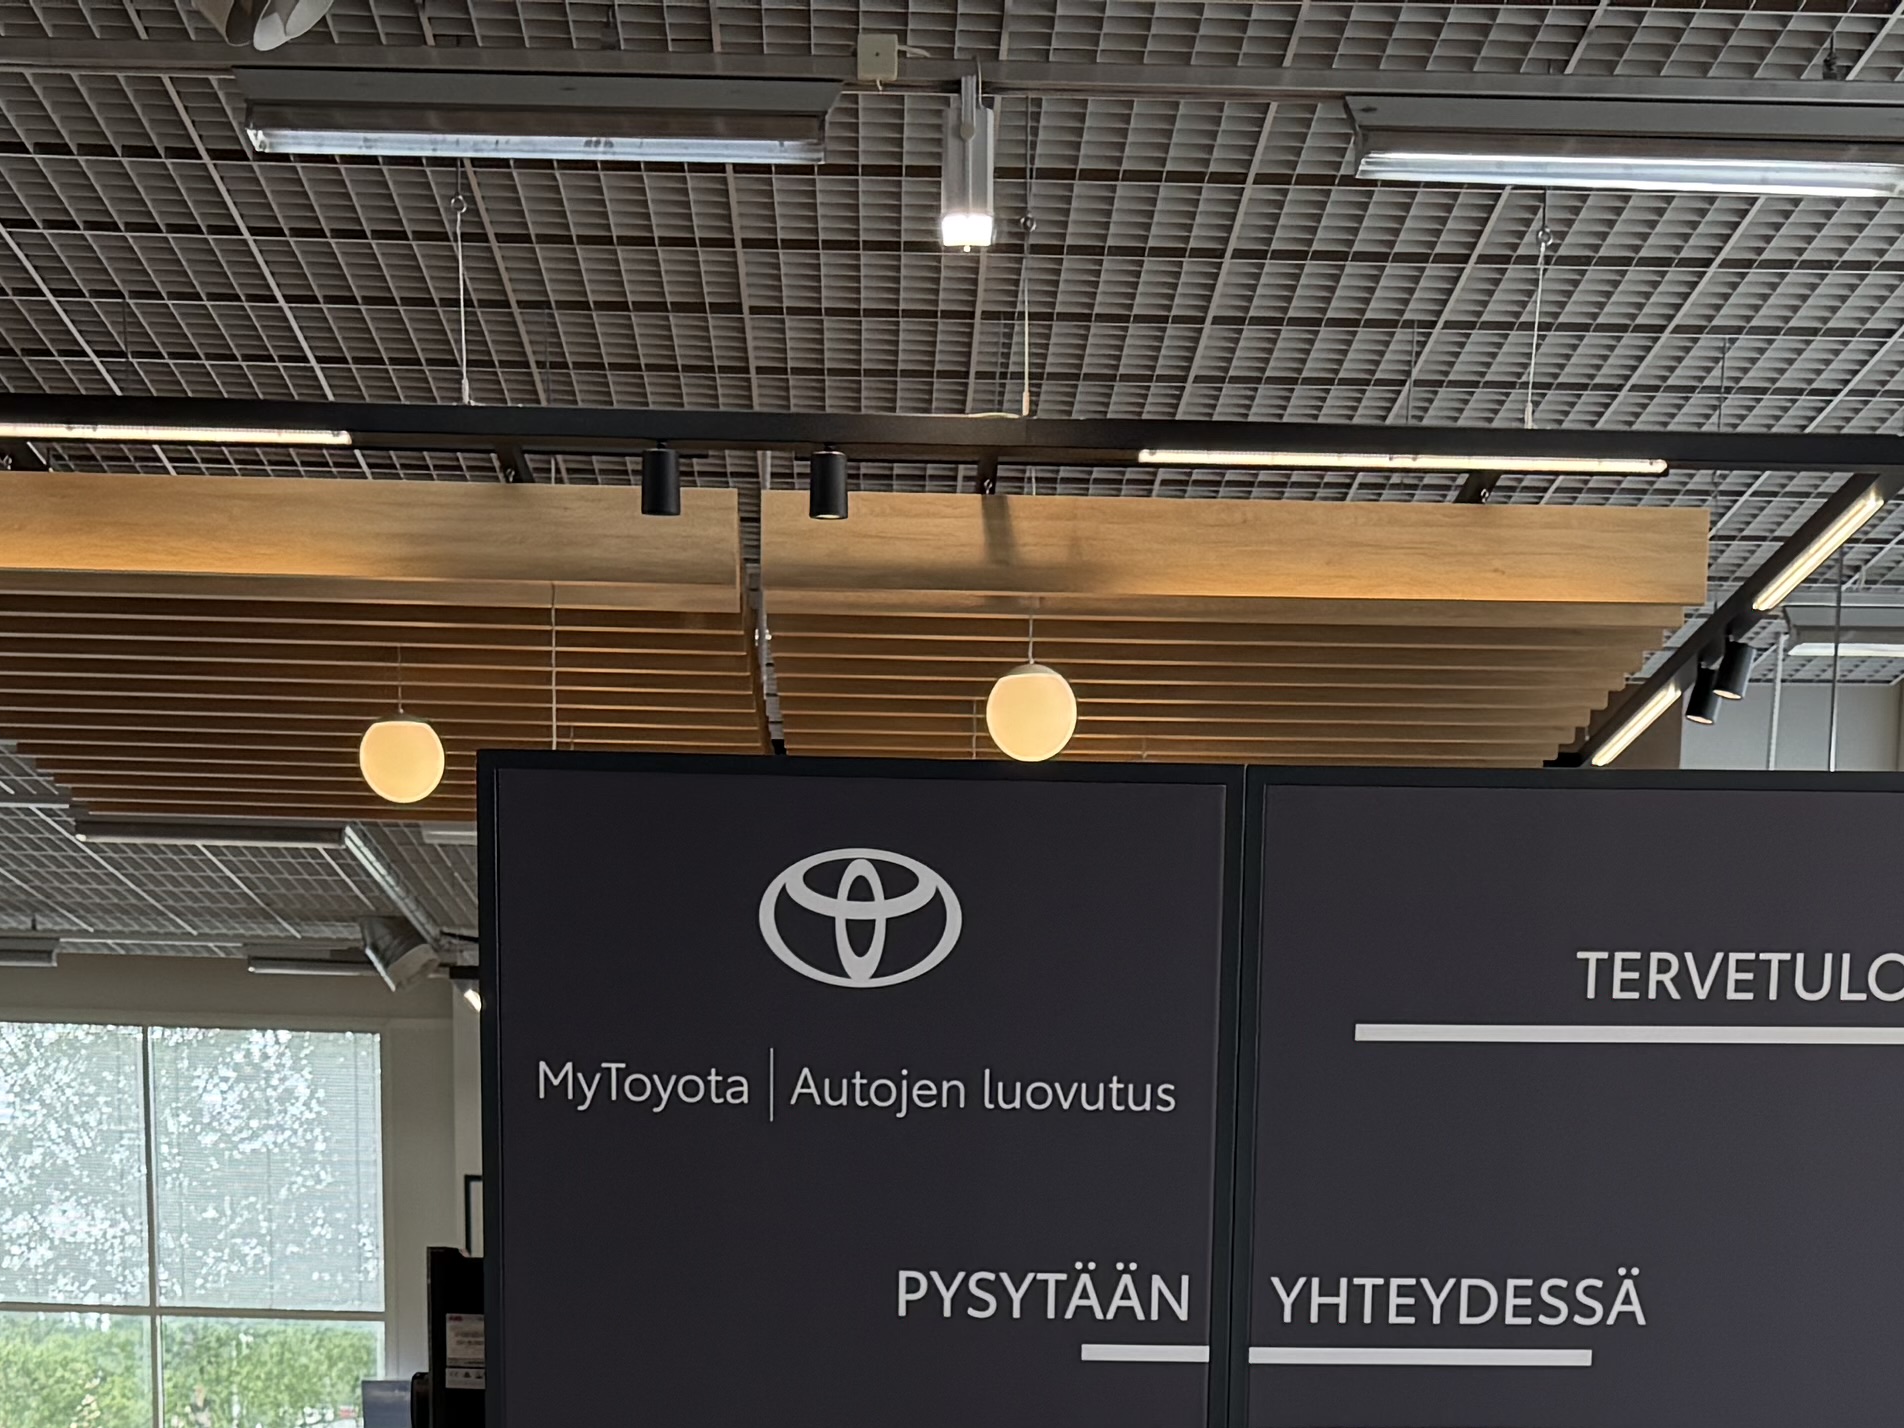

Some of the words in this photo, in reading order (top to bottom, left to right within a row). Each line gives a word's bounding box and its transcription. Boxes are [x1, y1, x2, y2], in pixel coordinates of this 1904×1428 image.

[538, 1060, 749, 1113] MyToyota
[790, 1067, 965, 1118] Autojen
[983, 1068, 1176, 1112] luovutus
[897, 1261, 1190, 1322] PYSYTÄÄN
[1270, 1266, 1647, 1326] YHTEYDESSÄ
